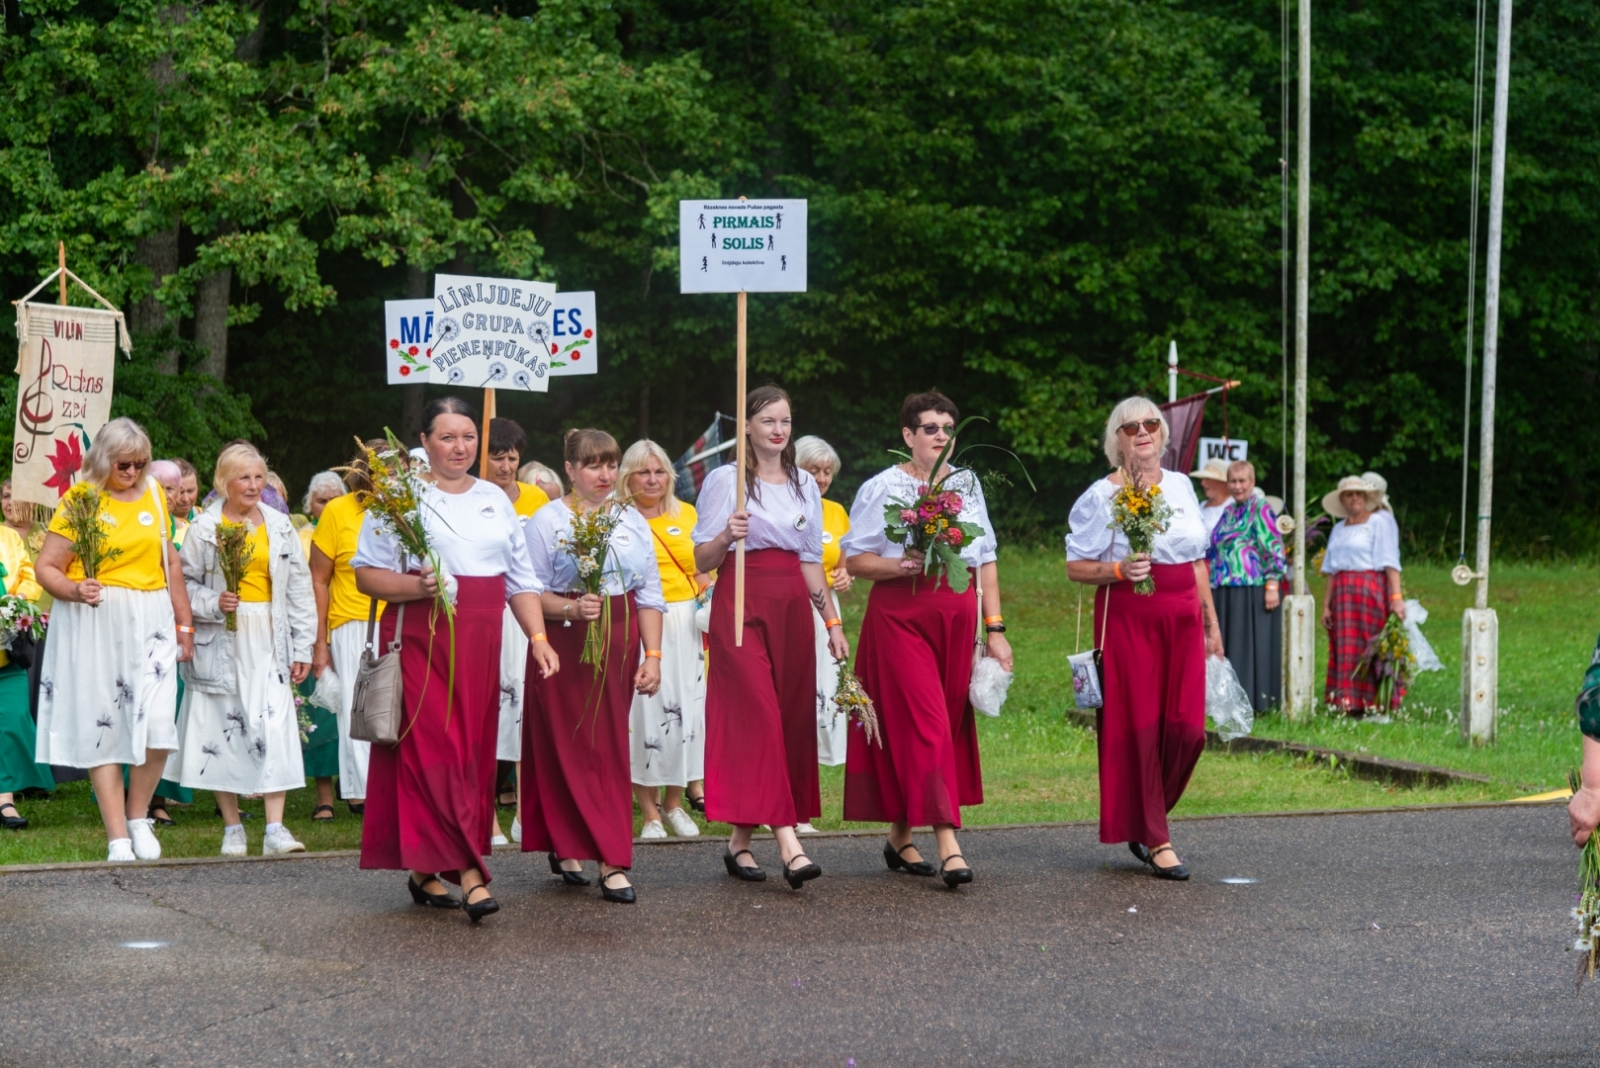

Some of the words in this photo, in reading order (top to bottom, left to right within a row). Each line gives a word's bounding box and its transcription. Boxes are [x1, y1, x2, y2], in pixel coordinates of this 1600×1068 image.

[713, 216, 775, 229] PIRMAIS
[722, 237, 765, 250] SOLIS
[437, 283, 553, 317] LĪNIJDEJU
[462, 312, 525, 335] GRUPA
[432, 339, 549, 378] PIENEŅPŪKAS
[1207, 443, 1240, 461] WC
